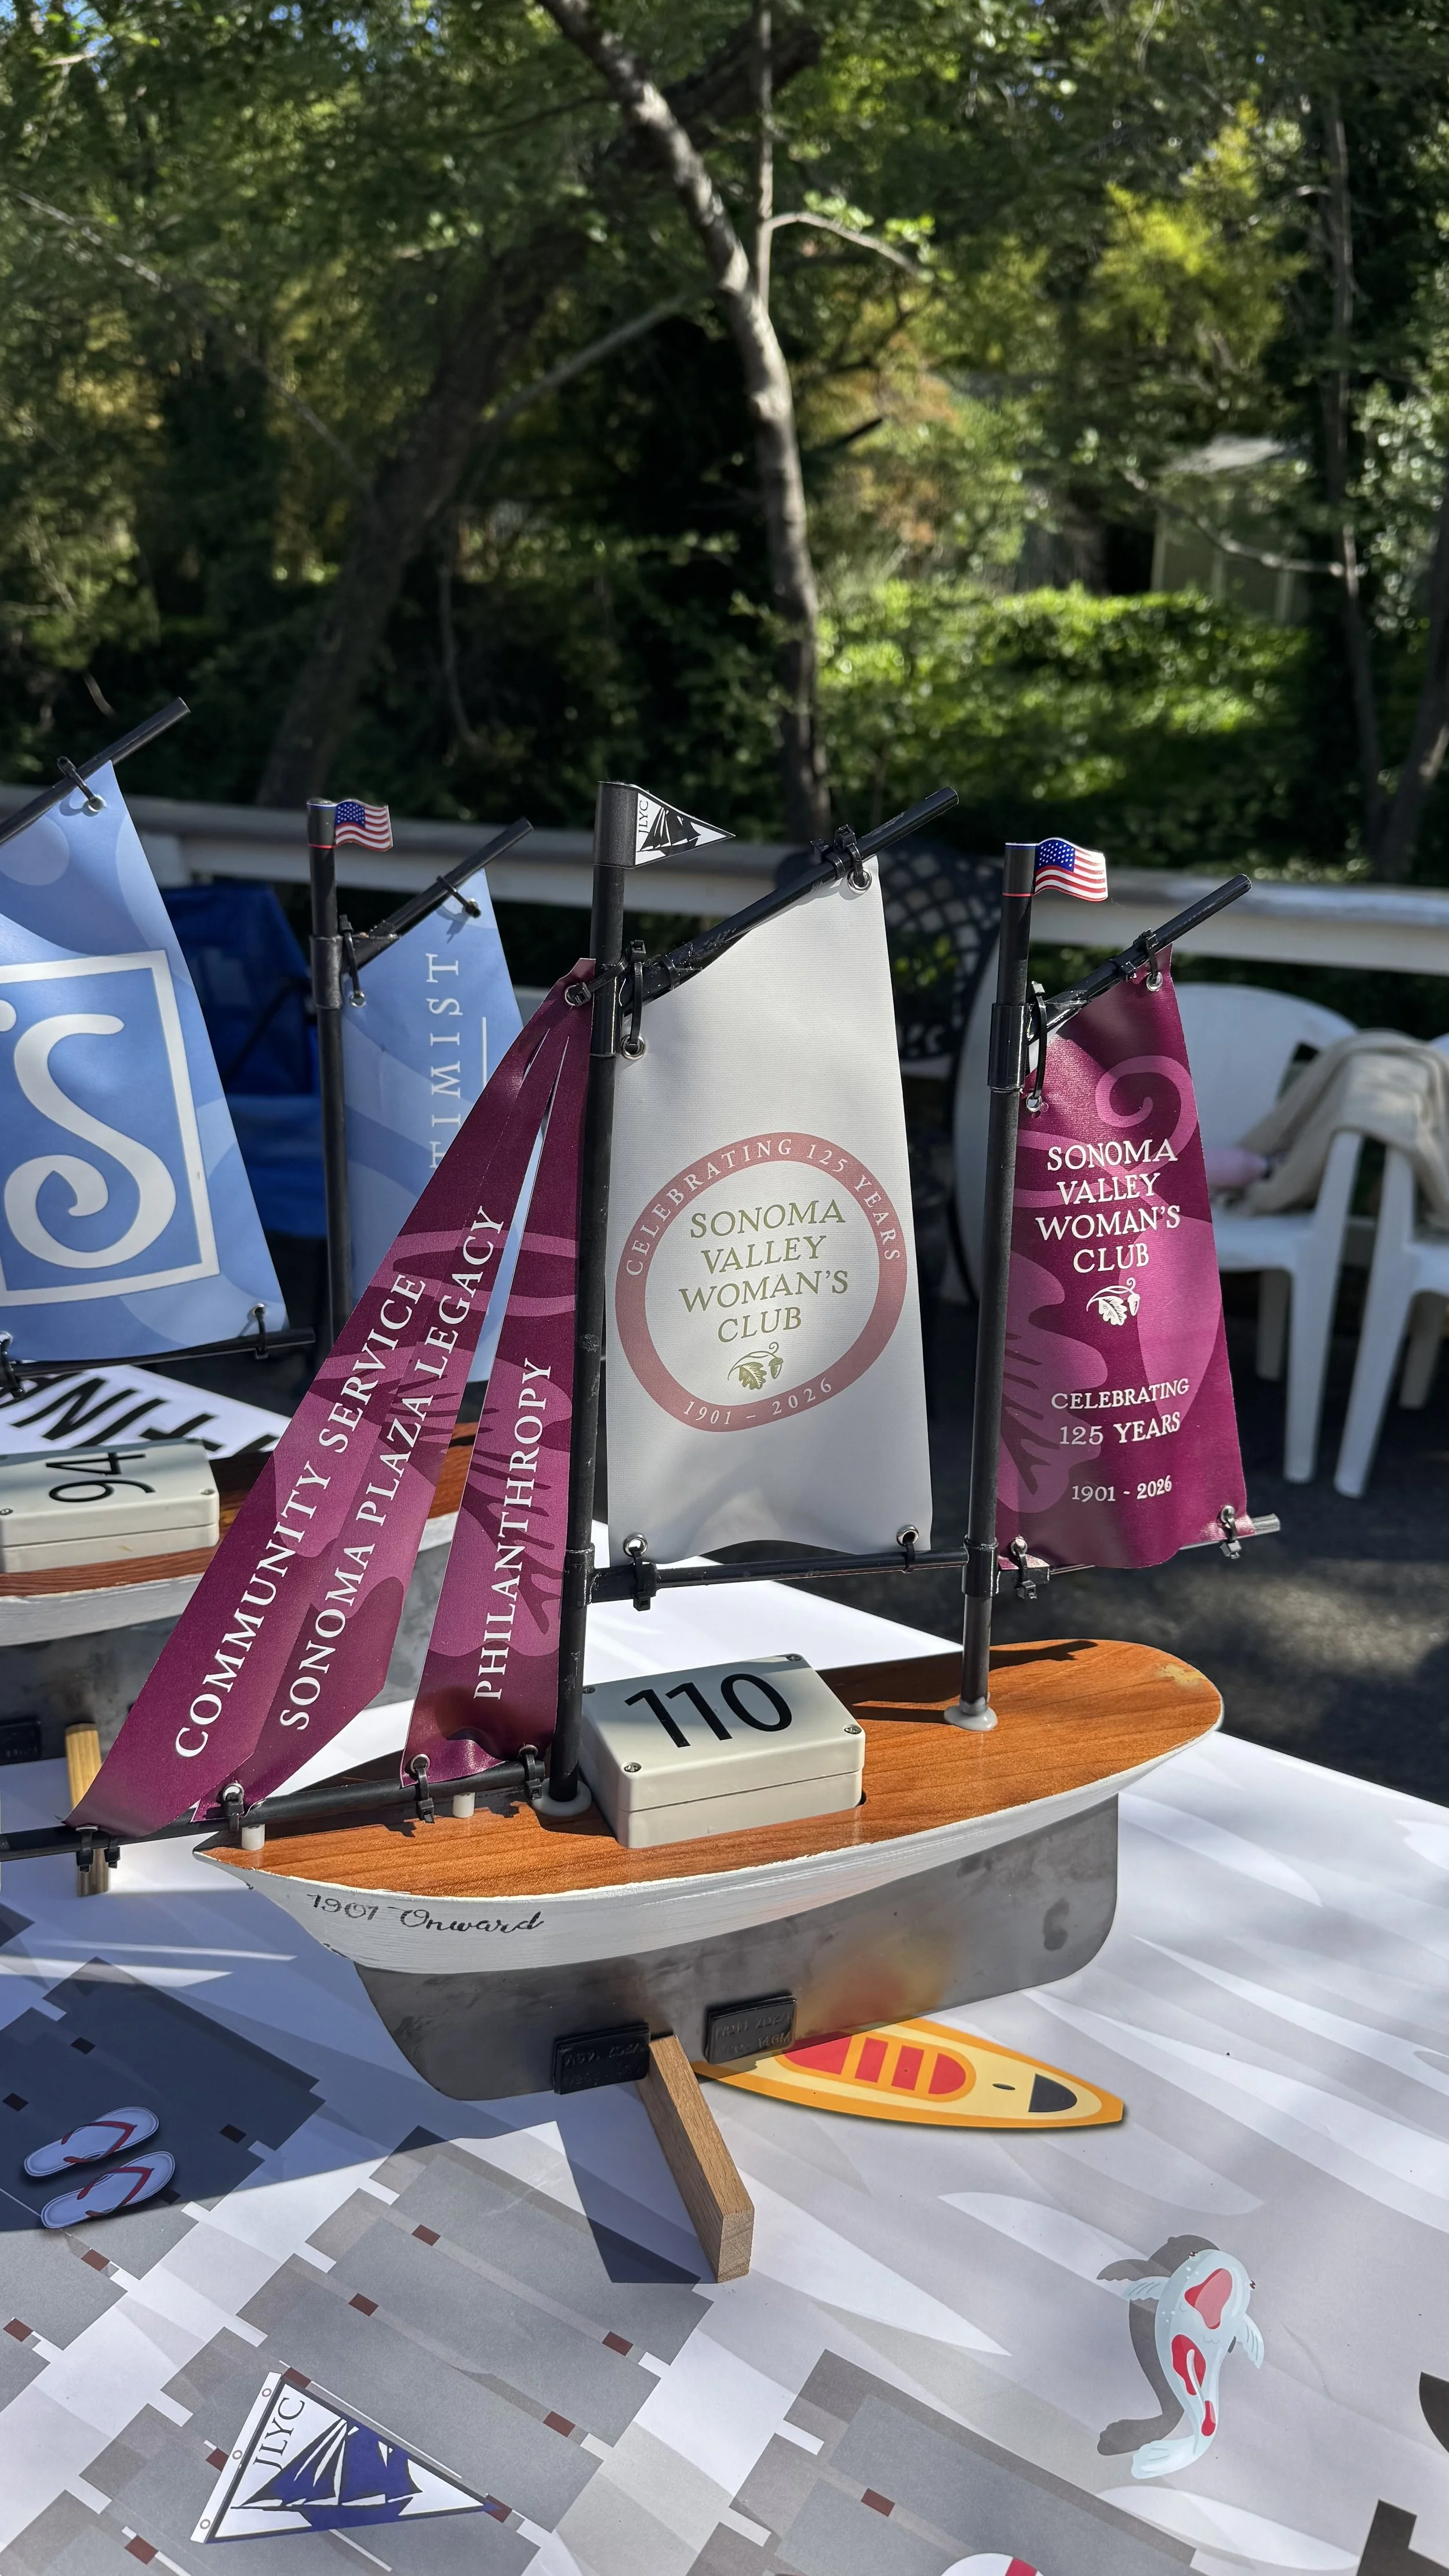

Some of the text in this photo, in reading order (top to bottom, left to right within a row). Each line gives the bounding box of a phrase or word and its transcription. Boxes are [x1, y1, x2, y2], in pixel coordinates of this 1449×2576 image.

[639, 800, 650, 834] JLYC
[1047, 1138, 1178, 1171] SONOMA
[626, 1138, 900, 1275] CELEBRATING 125 YEARS
[1057, 1172, 1161, 1205] VALLEY
[690, 1199, 846, 1239] SONOMA
[1035, 1205, 1181, 1241] WOMAN'S
[701, 1235, 827, 1274] VALLEY
[1073, 1243, 1149, 1274] CLUB
[679, 1270, 849, 1313] WOMAN'S
[718, 1307, 802, 1343] CLUB
[683, 1400, 731, 1425] 1901
[772, 1377, 832, 1415] 2026
[1051, 1378, 1189, 1410] CELEBRATING
[1059, 1411, 1181, 1446] 125 YEARS
[45, 1451, 156, 1503] 94
[280, 1205, 504, 1730] SONOMA PLAZA LEGACY
[1071, 1485, 1116, 1502] 1901
[1137, 1475, 1173, 1500] 2026
[176, 1274, 426, 1758] COMMUNITY SERVICE
[474, 1357, 551, 1700] PHILANTHROPY
[624, 1673, 792, 1748] 110
[307, 1894, 545, 1933] 1901 Onward
[253, 2397, 305, 2471] JLYC
